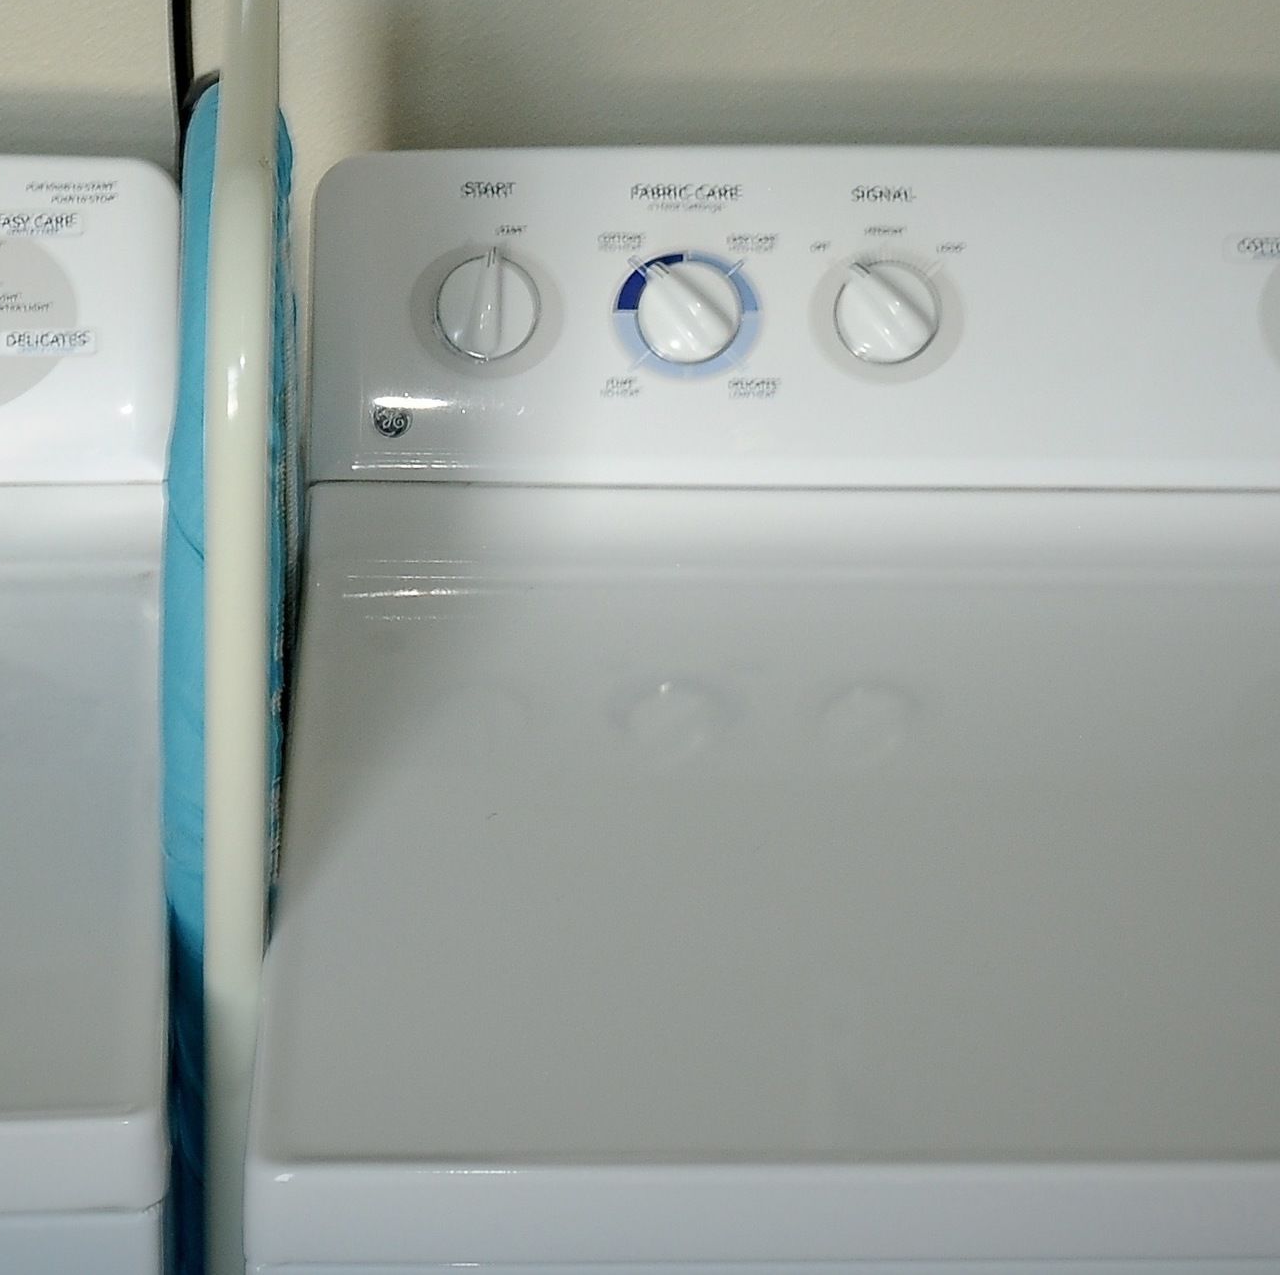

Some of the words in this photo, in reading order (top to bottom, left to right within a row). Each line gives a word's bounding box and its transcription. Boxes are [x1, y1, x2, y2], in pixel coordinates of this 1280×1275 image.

[88, 192, 119, 203] STOP
[460, 181, 516, 198] START
[631, 183, 692, 200] FABRIC
[695, 183, 743, 200] CARE
[850, 185, 917, 202] SIGNAL
[33, 212, 78, 229] CARE
[6, 330, 90, 348] DELICATES
